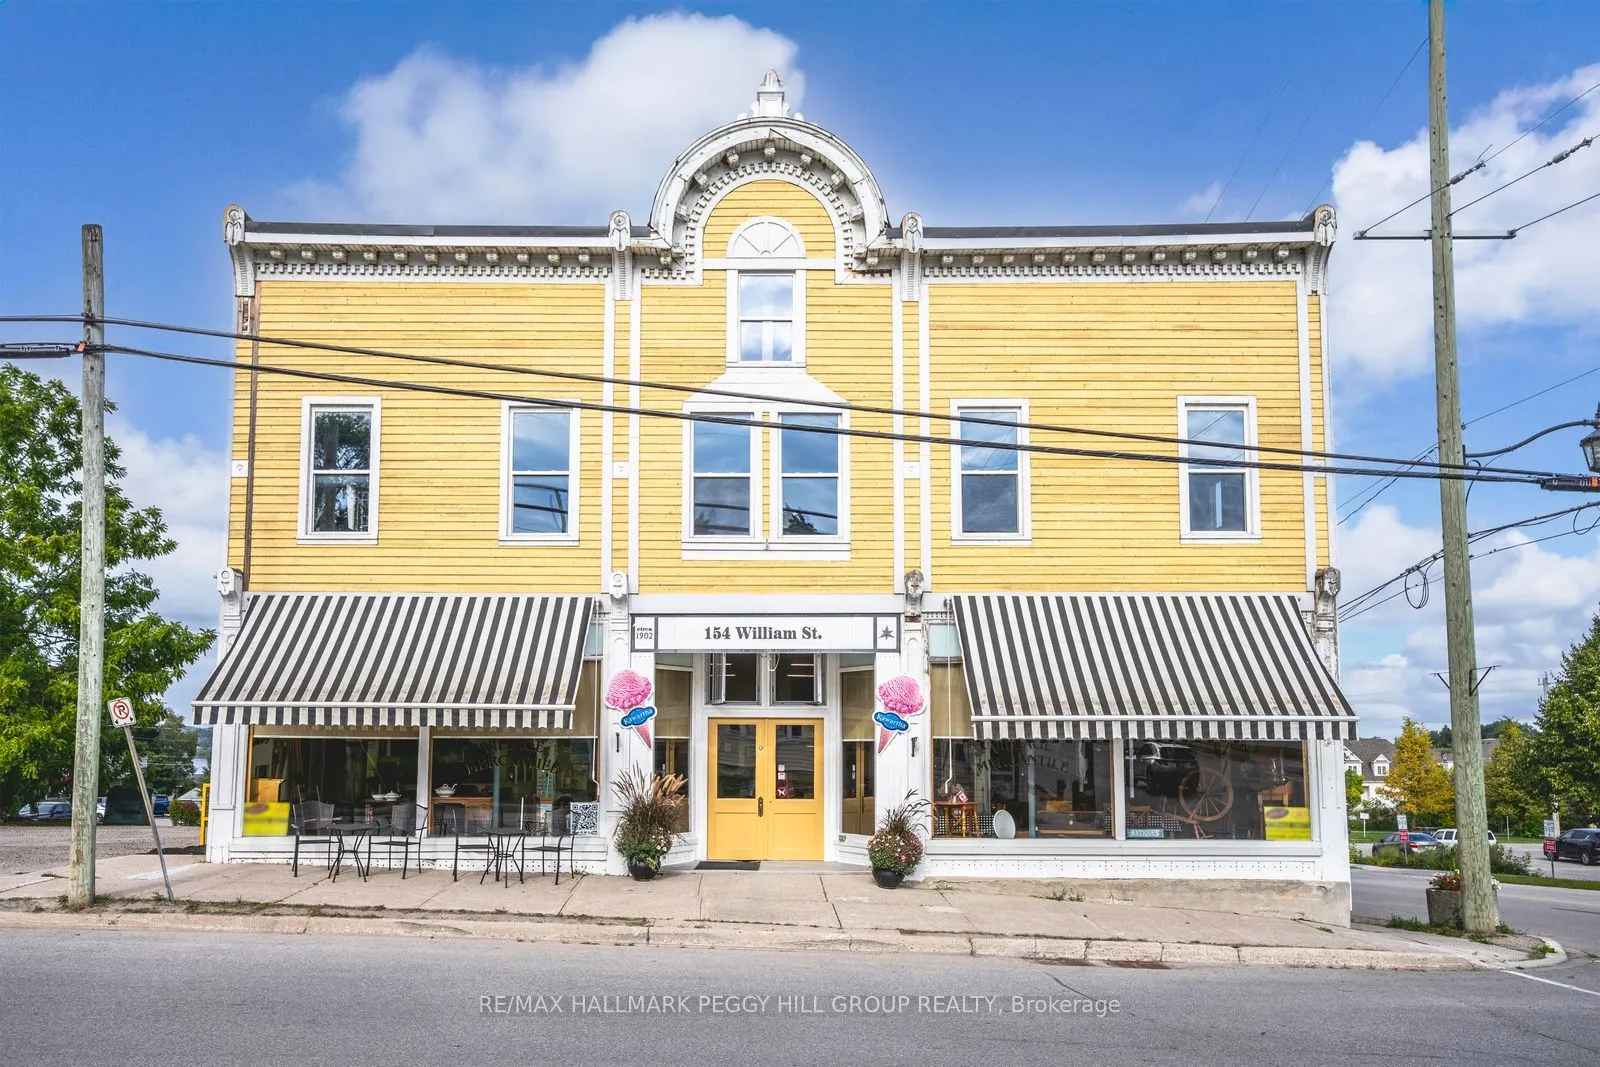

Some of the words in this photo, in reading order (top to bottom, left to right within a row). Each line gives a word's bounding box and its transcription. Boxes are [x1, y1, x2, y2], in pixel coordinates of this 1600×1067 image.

[636, 632, 653, 640] 1902
[704, 626, 731, 640] 154
[735, 626, 798, 640] William
[801, 626, 823, 640] St.
[623, 709, 653, 725] Kawartha
[876, 713, 907, 729] Kawartha
